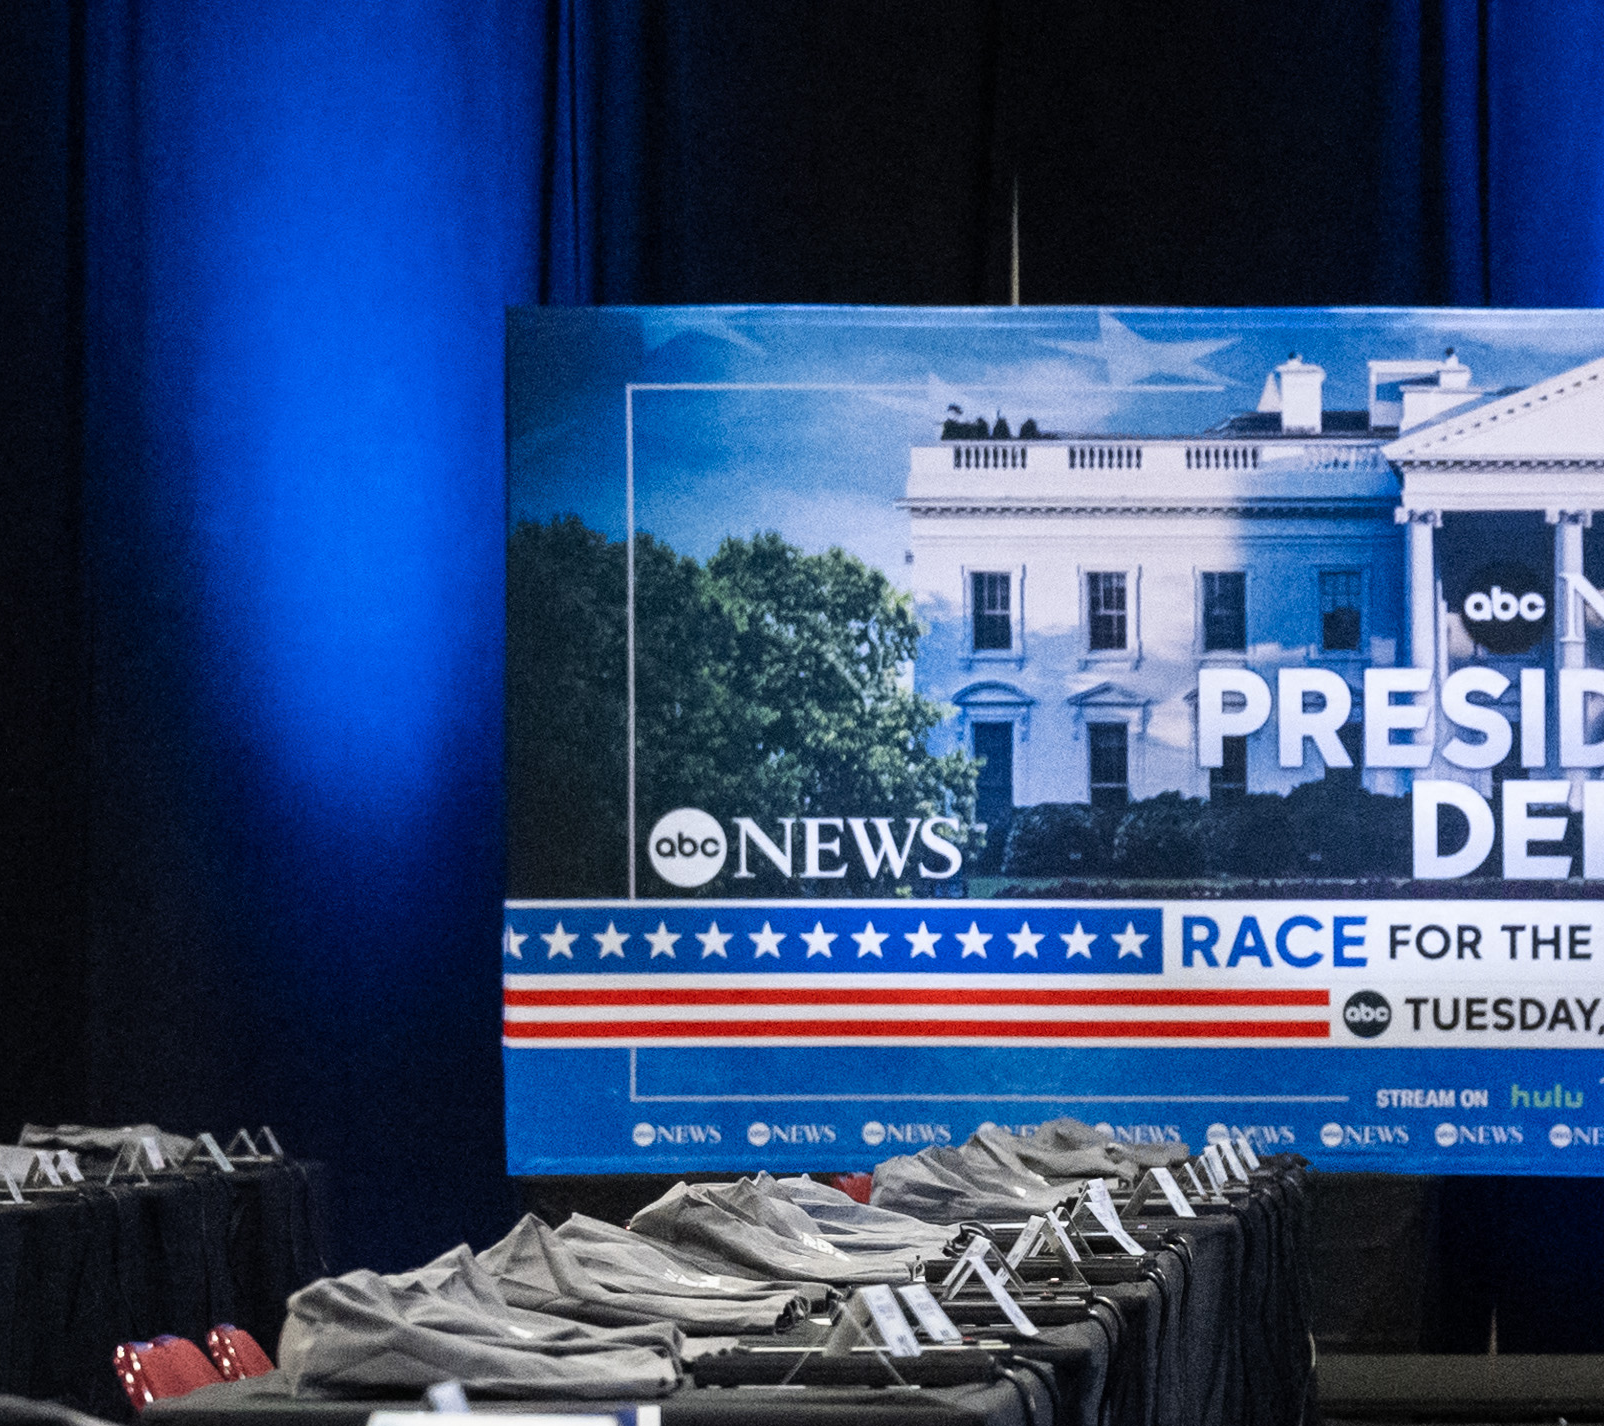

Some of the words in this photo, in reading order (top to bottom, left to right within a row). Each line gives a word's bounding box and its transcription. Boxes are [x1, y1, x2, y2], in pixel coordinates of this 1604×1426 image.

[1464, 585, 1546, 623] abc
[655, 831, 721, 859] abc
[732, 816, 963, 880] NEWS
[1180, 914, 1369, 969] RACE
[1389, 924, 1482, 962] FOR
[1501, 924, 1594, 962] THE
[1345, 1002, 1390, 1023] abc
[1375, 1088, 1456, 1109] STREAM
[1460, 1088, 1489, 1109] ON
[1510, 1083, 1584, 1109] hulu
[657, 1124, 721, 1144] NEWS
[771, 1125, 836, 1144] NEWS
[885, 1124, 951, 1143] NEWS
[1345, 1125, 1409, 1144] NEWS
[1459, 1125, 1523, 1145] NEWS
